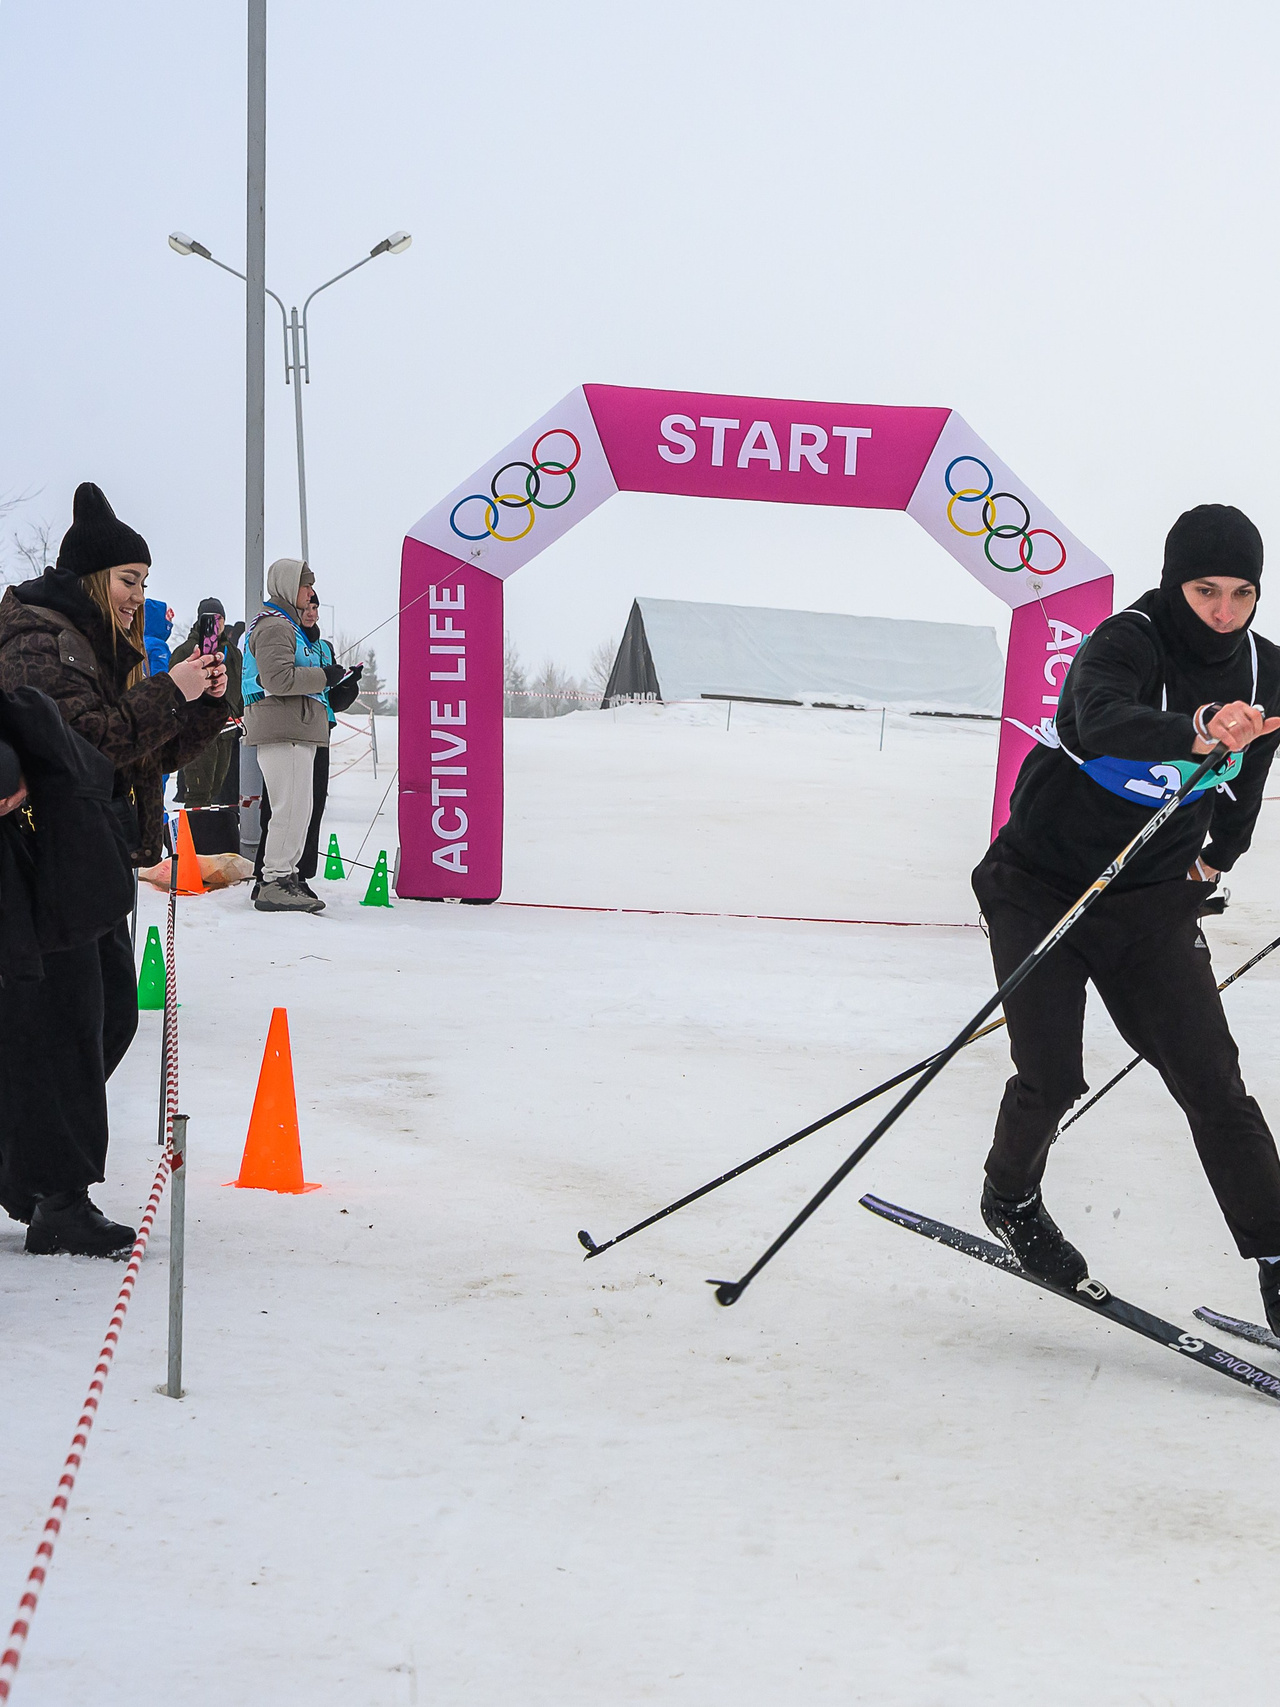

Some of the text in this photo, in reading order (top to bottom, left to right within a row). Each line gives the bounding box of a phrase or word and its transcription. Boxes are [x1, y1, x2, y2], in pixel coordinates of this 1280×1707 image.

[658, 414, 872, 476] START
[429, 584, 469, 874] ACTIVE LIFE
